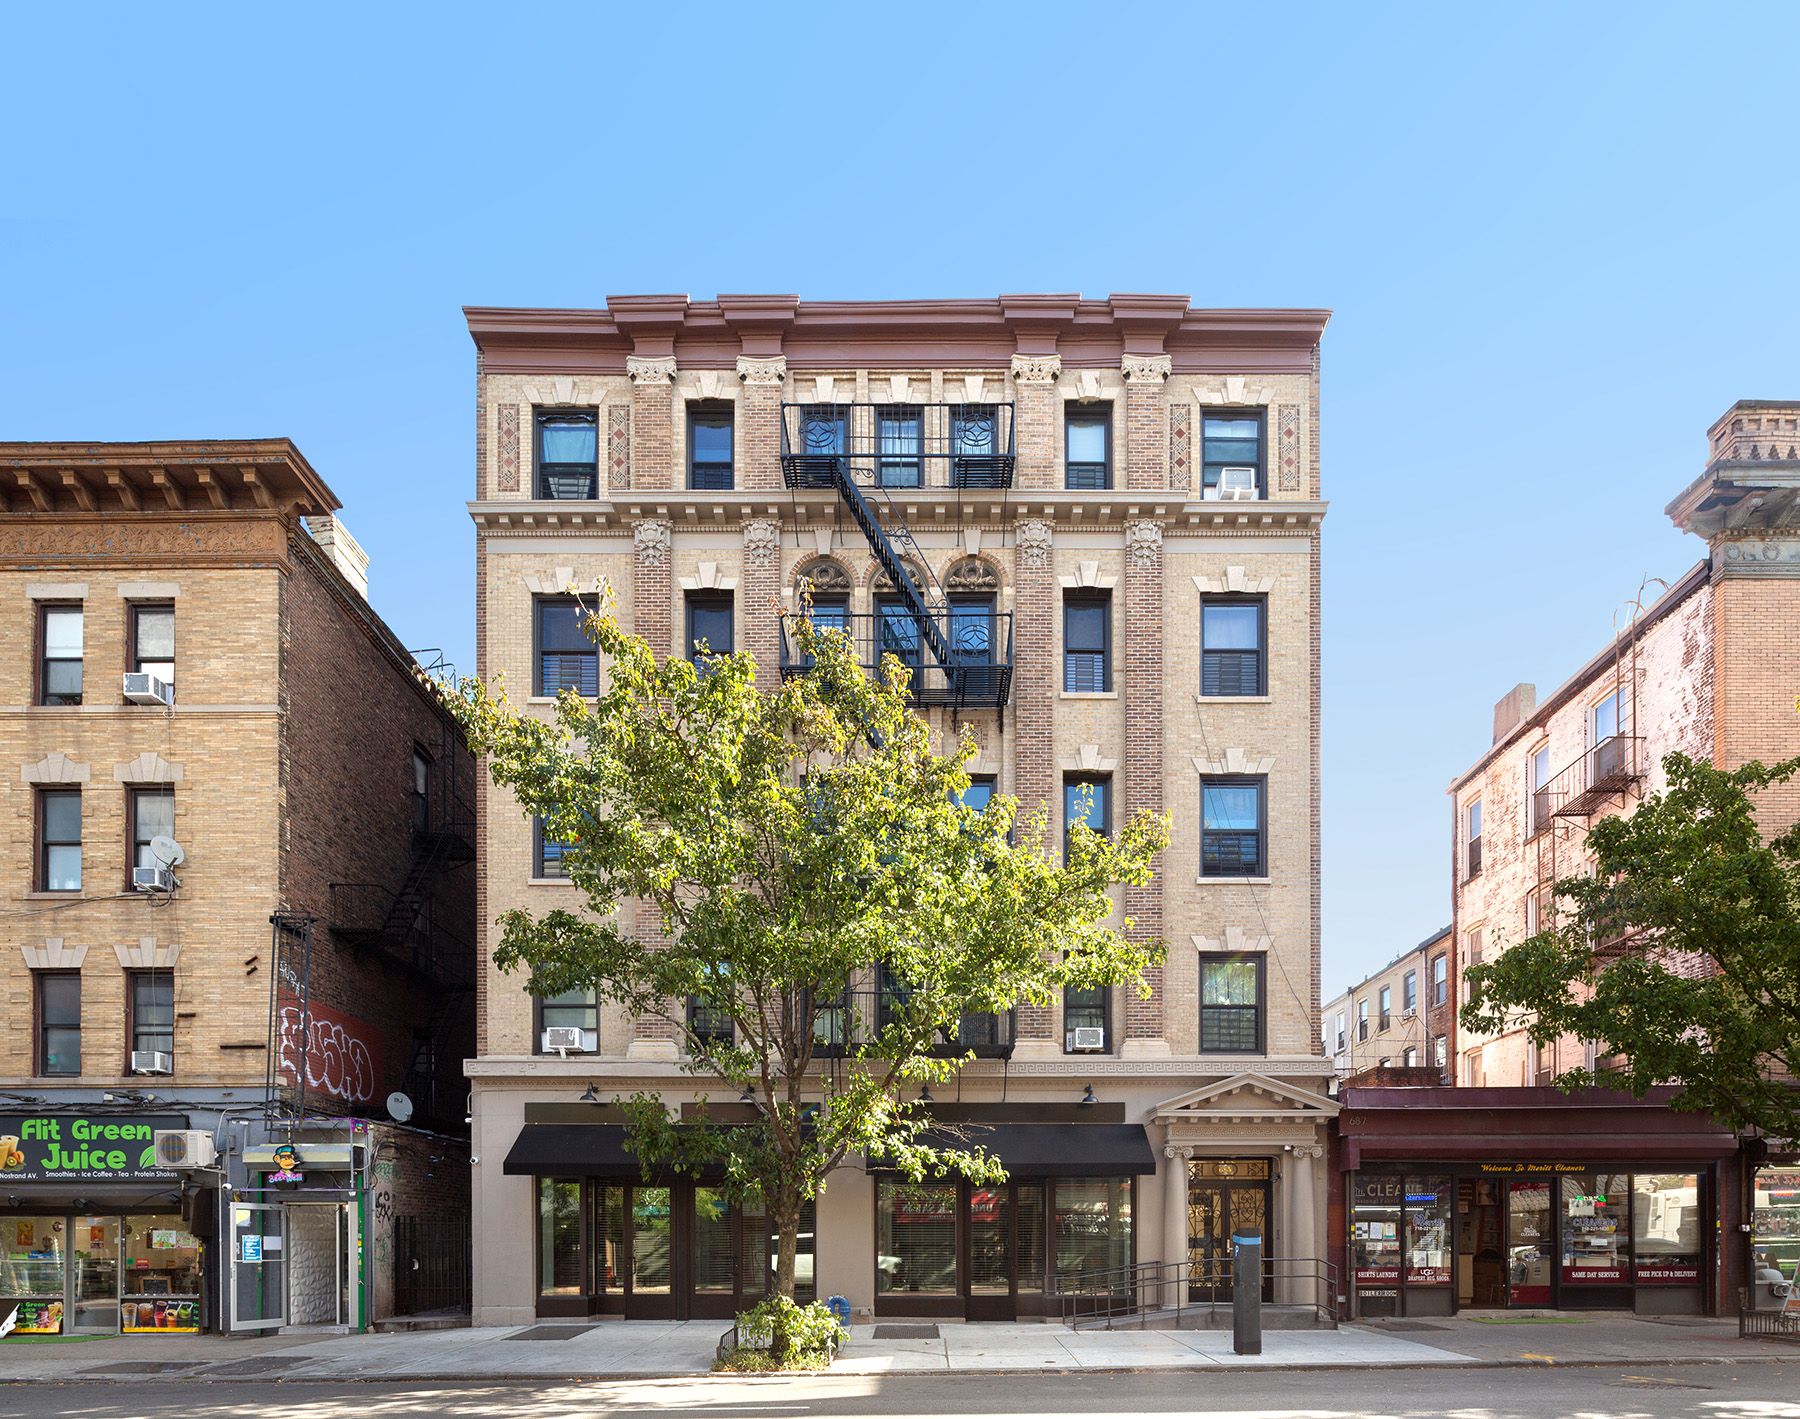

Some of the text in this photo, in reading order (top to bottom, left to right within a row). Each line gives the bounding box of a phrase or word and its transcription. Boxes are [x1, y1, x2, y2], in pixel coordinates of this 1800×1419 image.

[1349, 1116, 1366, 1126] 687
[22, 1119, 151, 1140] Flit Green
[40, 1143, 127, 1169] Juice
[1481, 1164, 1512, 1172] Welcome
[1515, 1164, 1525, 1173] To
[1554, 1163, 1585, 1172] Cleaners
[1572, 1218, 1618, 1227] CLEANERS
